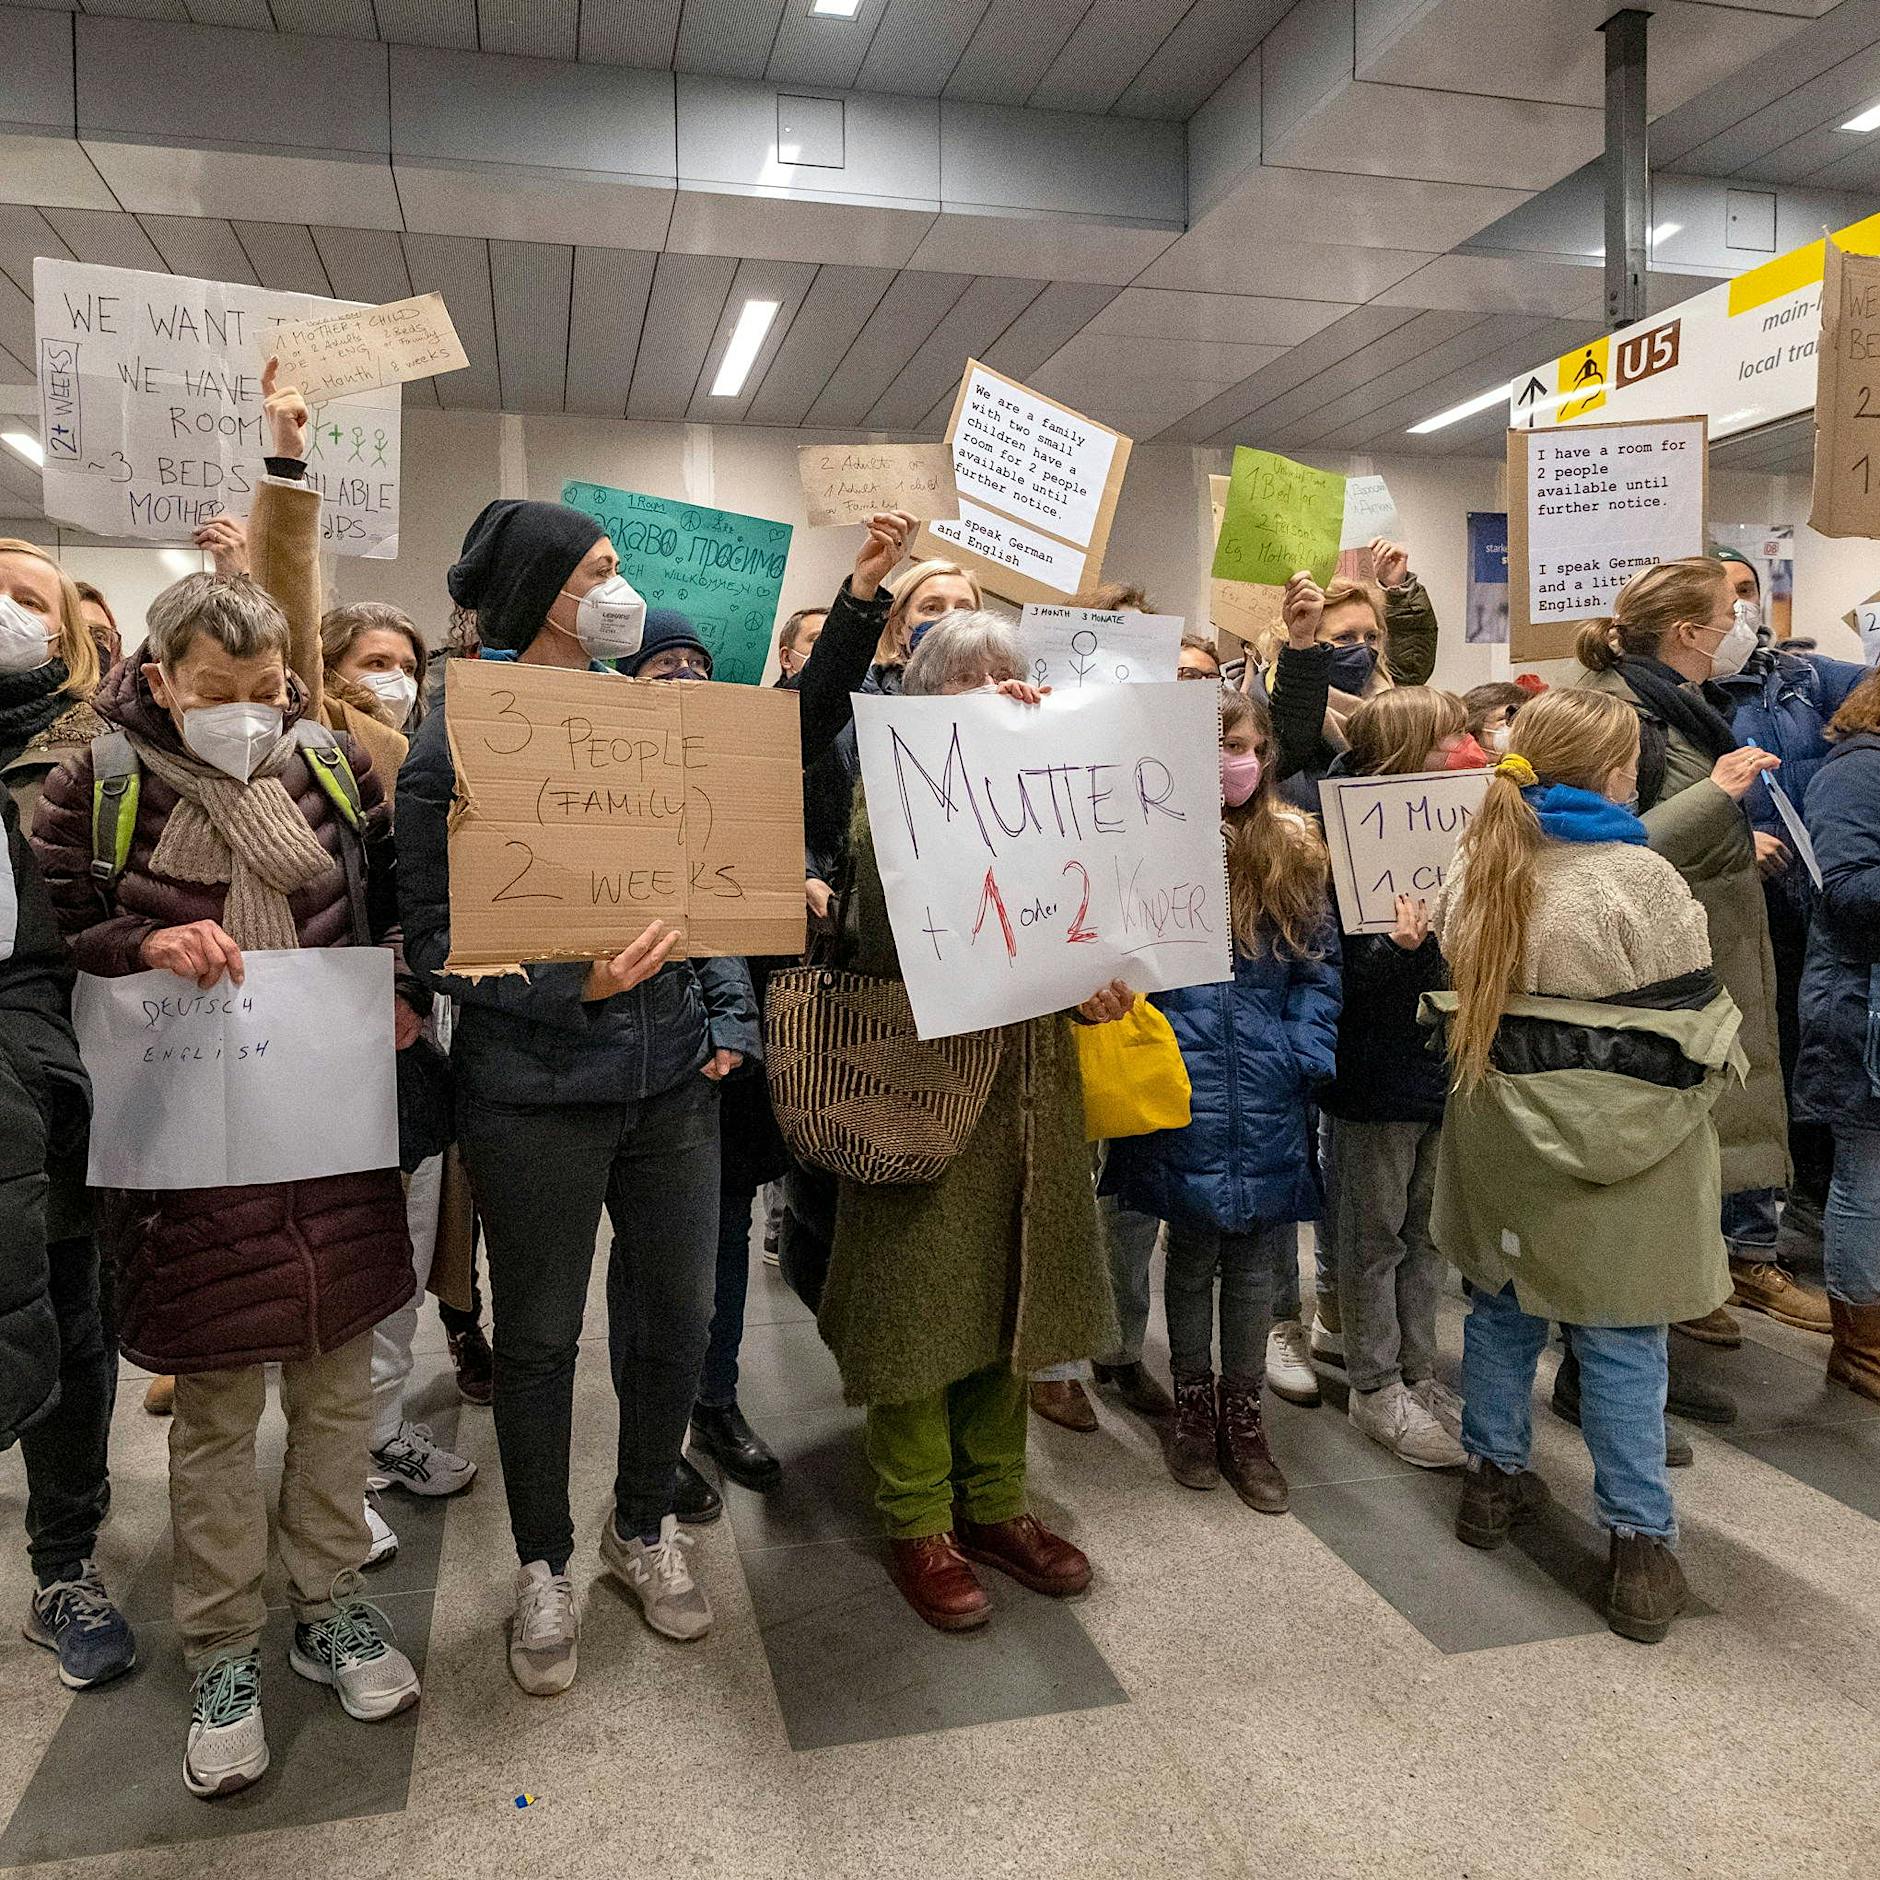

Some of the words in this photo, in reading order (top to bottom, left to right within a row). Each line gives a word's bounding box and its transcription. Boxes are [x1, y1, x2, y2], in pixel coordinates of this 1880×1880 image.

[64, 292, 120, 335] WE
[147, 302, 246, 347] WANT
[292, 321, 348, 346] MOTHER
[368, 308, 420, 327] CHILD
[1623, 326, 1674, 379] U5
[1738, 346, 1782, 381] local
[1788, 338, 1819, 364] tra
[47, 347, 74, 416] WEEKS
[117, 355, 161, 394] WE
[185, 368, 257, 406] HAVE
[169, 407, 264, 447] ROOM
[972, 400, 1001, 423] with
[1009, 419, 1031, 436] two
[1037, 434, 1074, 457] small
[975, 384, 991, 400] We
[998, 397, 1020, 414] are
[1026, 412, 1034, 421] a
[1041, 418, 1086, 447] family
[963, 432, 993, 453] room
[1000, 449, 1022, 467] for
[1028, 462, 1037, 474] 2
[1042, 470, 1087, 498] people
[967, 417, 1026, 452] children
[1033, 447, 1063, 469] have
[1069, 466, 1078, 476] a
[1537, 449, 1546, 461] I
[1555, 447, 1591, 460] have
[1599, 446, 1609, 456] a
[1617, 443, 1653, 455] room
[1661, 439, 1687, 452] for
[158, 457, 251, 493] BEDS
[955, 462, 1007, 494] further
[1013, 490, 1062, 520] notice.
[958, 448, 1026, 486] available
[1032, 482, 1069, 506] until
[1537, 467, 1546, 480] 2
[1554, 463, 1609, 481] people
[1537, 480, 1618, 498] available
[1626, 476, 1669, 491] until
[1537, 501, 1600, 516] further
[1608, 496, 1668, 511] notice.
[937, 523, 962, 542] and
[966, 535, 1021, 568] English
[964, 518, 1002, 542] speak
[1008, 537, 1055, 565] German
[1538, 580, 1566, 593] and
[1574, 580, 1583, 590] a
[1539, 564, 1547, 576] I
[1557, 559, 1601, 576] speak
[1609, 555, 1661, 570] German
[1030, 606, 1039, 617] 3
[1041, 607, 1071, 619] MONTH
[1081, 611, 1088, 622] 3
[1090, 612, 1126, 626] MONATE
[1538, 594, 1608, 613] English.
[483, 690, 533, 755] 3
[560, 714, 709, 783] PEOPLE
[886, 721, 1188, 861] MUTTER
[1360, 801, 1385, 840] 1
[492, 840, 564, 903] 2
[590, 859, 747, 906] WEEKS
[1372, 869, 1395, 894] 1
[921, 905, 949, 962] +
[970, 864, 1018, 969] 1
[1019, 897, 1059, 928] oder
[1062, 859, 1099, 944] 2
[142, 995, 253, 1031] DEUTSCH
[142, 1038, 270, 1064] ENGLISH
